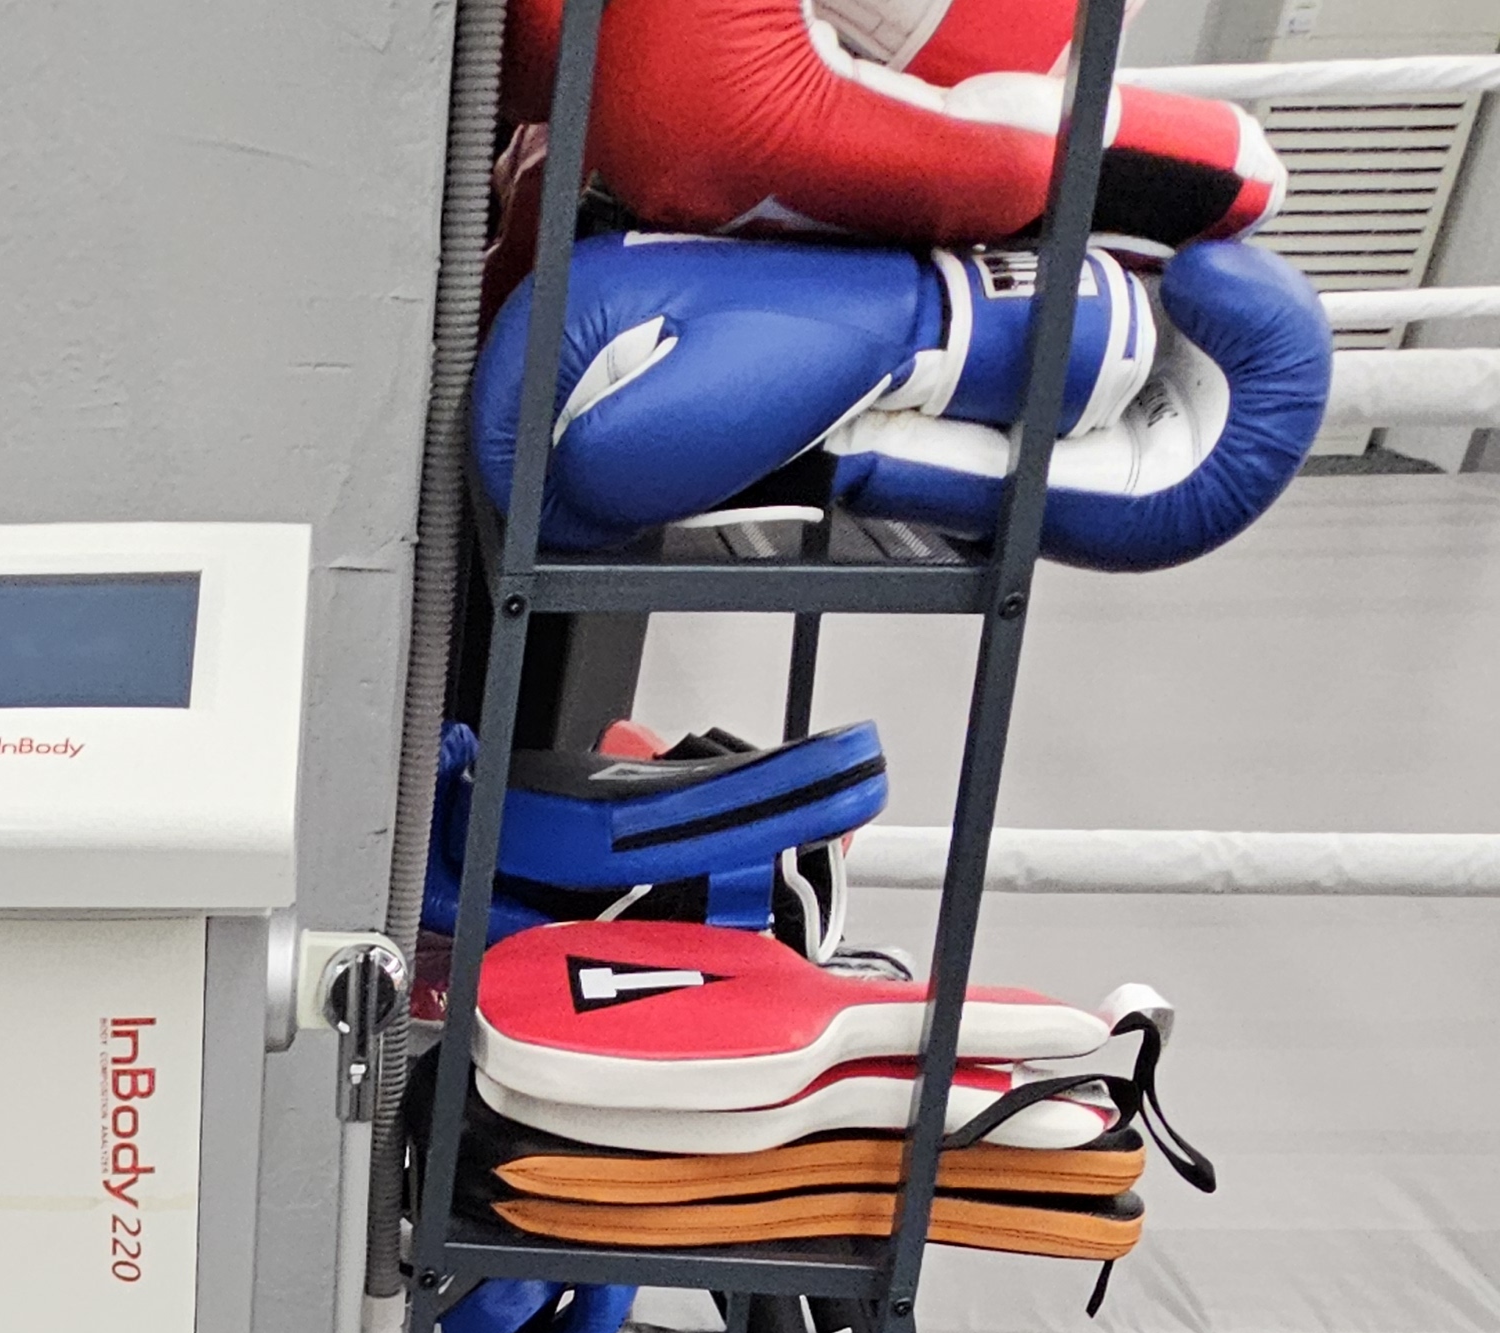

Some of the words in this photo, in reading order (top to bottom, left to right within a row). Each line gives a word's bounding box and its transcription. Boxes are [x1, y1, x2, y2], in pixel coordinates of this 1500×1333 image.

[100, 1051, 108, 1119] COMPOSITION
[103, 1017, 157, 1209] InBody
[100, 1124, 109, 1174] ANALYZER
[111, 1214, 141, 1282] 220
